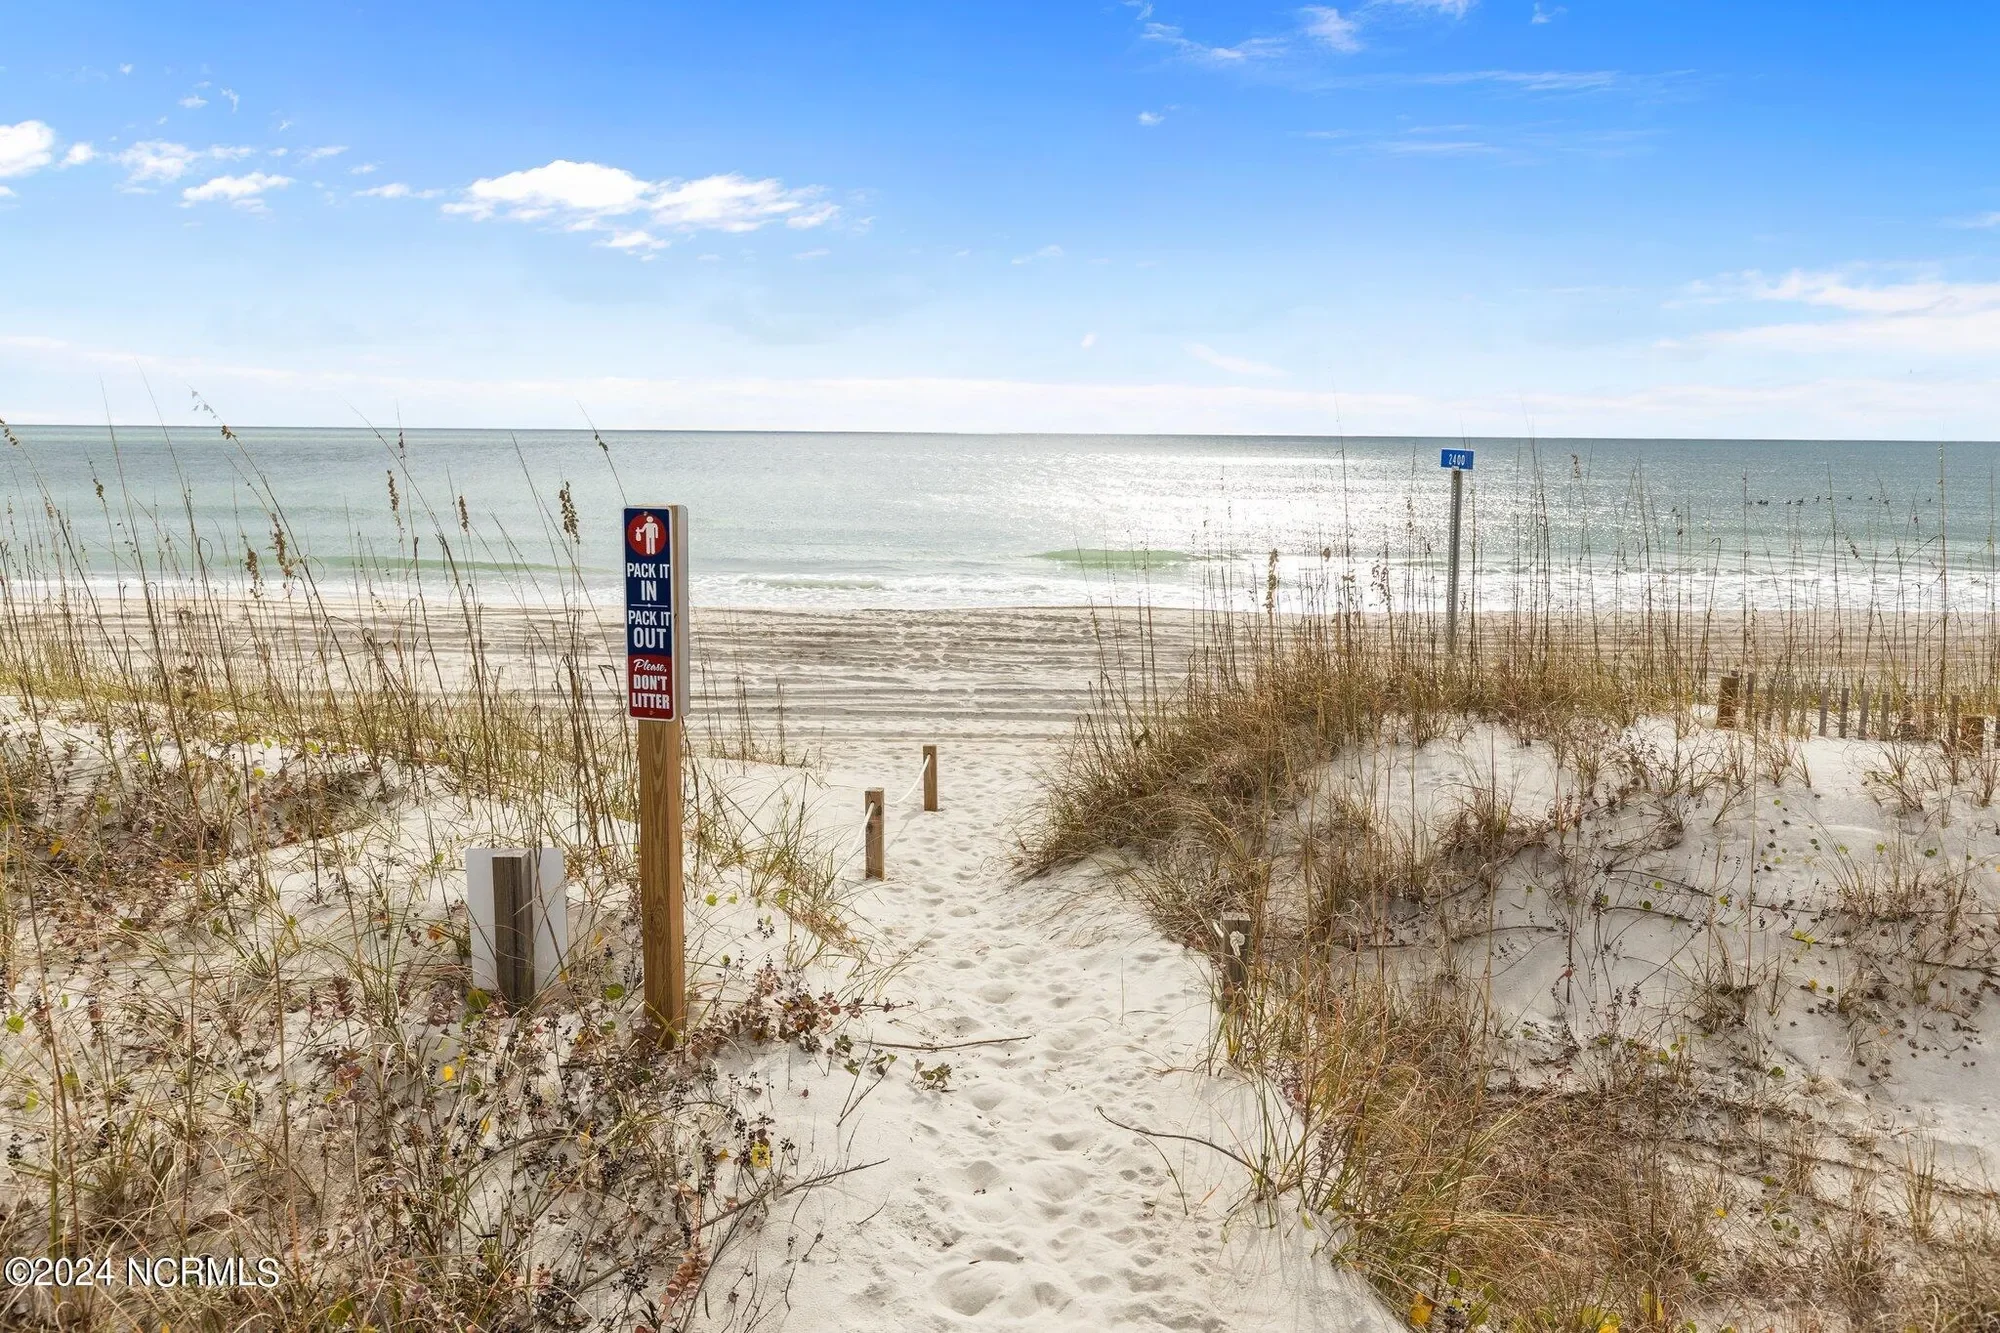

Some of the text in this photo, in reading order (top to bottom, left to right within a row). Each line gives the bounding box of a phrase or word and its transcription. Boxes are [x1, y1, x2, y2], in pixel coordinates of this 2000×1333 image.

[1448, 453, 1466, 466] 2400
[626, 562, 670, 579] PACK IT
[640, 580, 657, 602] IN
[628, 609, 671, 627] PACK IT
[633, 627, 667, 649] OUT
[633, 658, 667, 673] Please,
[633, 674, 668, 691] DON'T
[631, 692, 670, 710] LITTER
